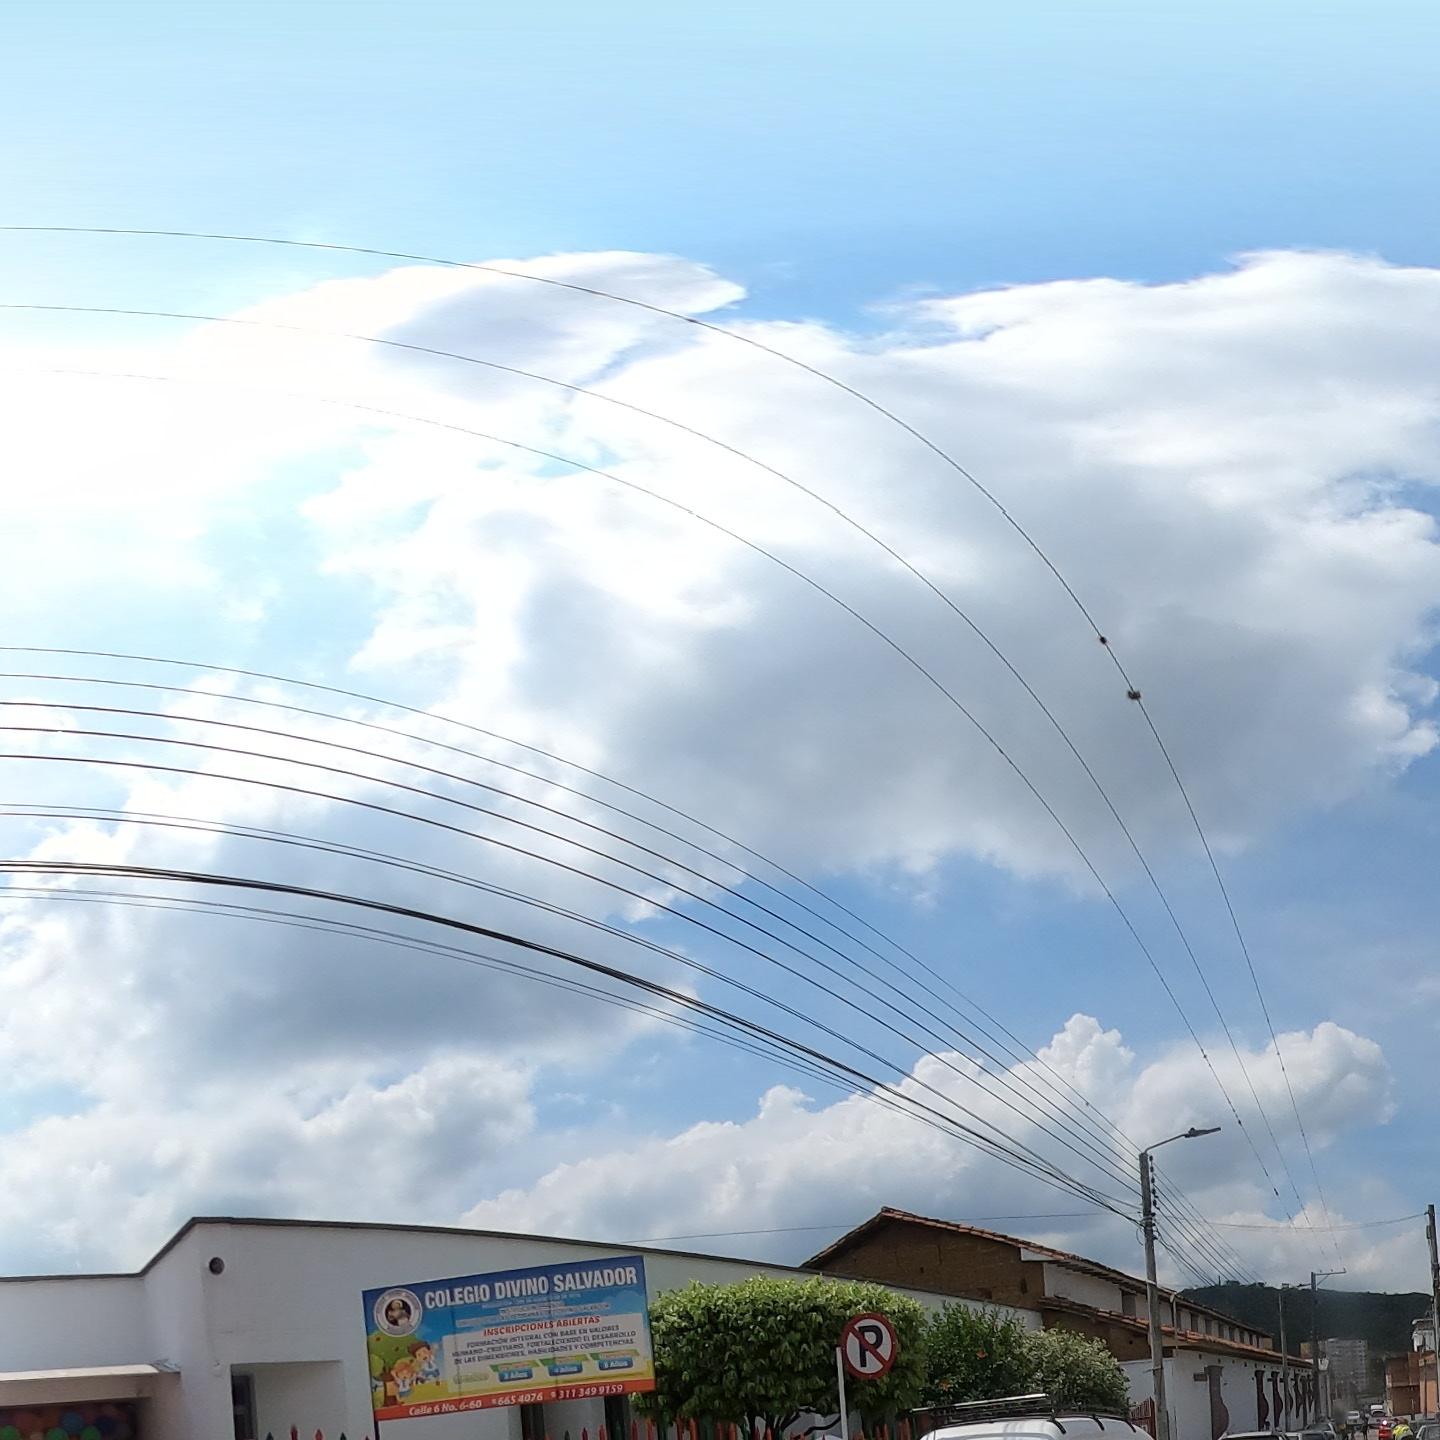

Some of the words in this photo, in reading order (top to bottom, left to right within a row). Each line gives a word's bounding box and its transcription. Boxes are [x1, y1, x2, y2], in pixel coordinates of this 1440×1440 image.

[424, 1283, 490, 1308] COLEGIO
[495, 1276, 549, 1300] DIVINO
[554, 1266, 637, 1293] SALVADOR
[483, 1320, 553, 1336] INSCRIPCIONES
[556, 1315, 599, 1327] ABIERTAS
[409, 1405, 432, 1415] Calle
[441, 1402, 457, 1411] No.
[459, 1399, 481, 1409] 6-60
[498, 1396, 515, 1405] 665
[518, 1393, 542, 1402] 4076
[558, 1389, 575, 1398] 311
[578, 1386, 596, 1396] 349
[599, 1383, 622, 1394] 9159
